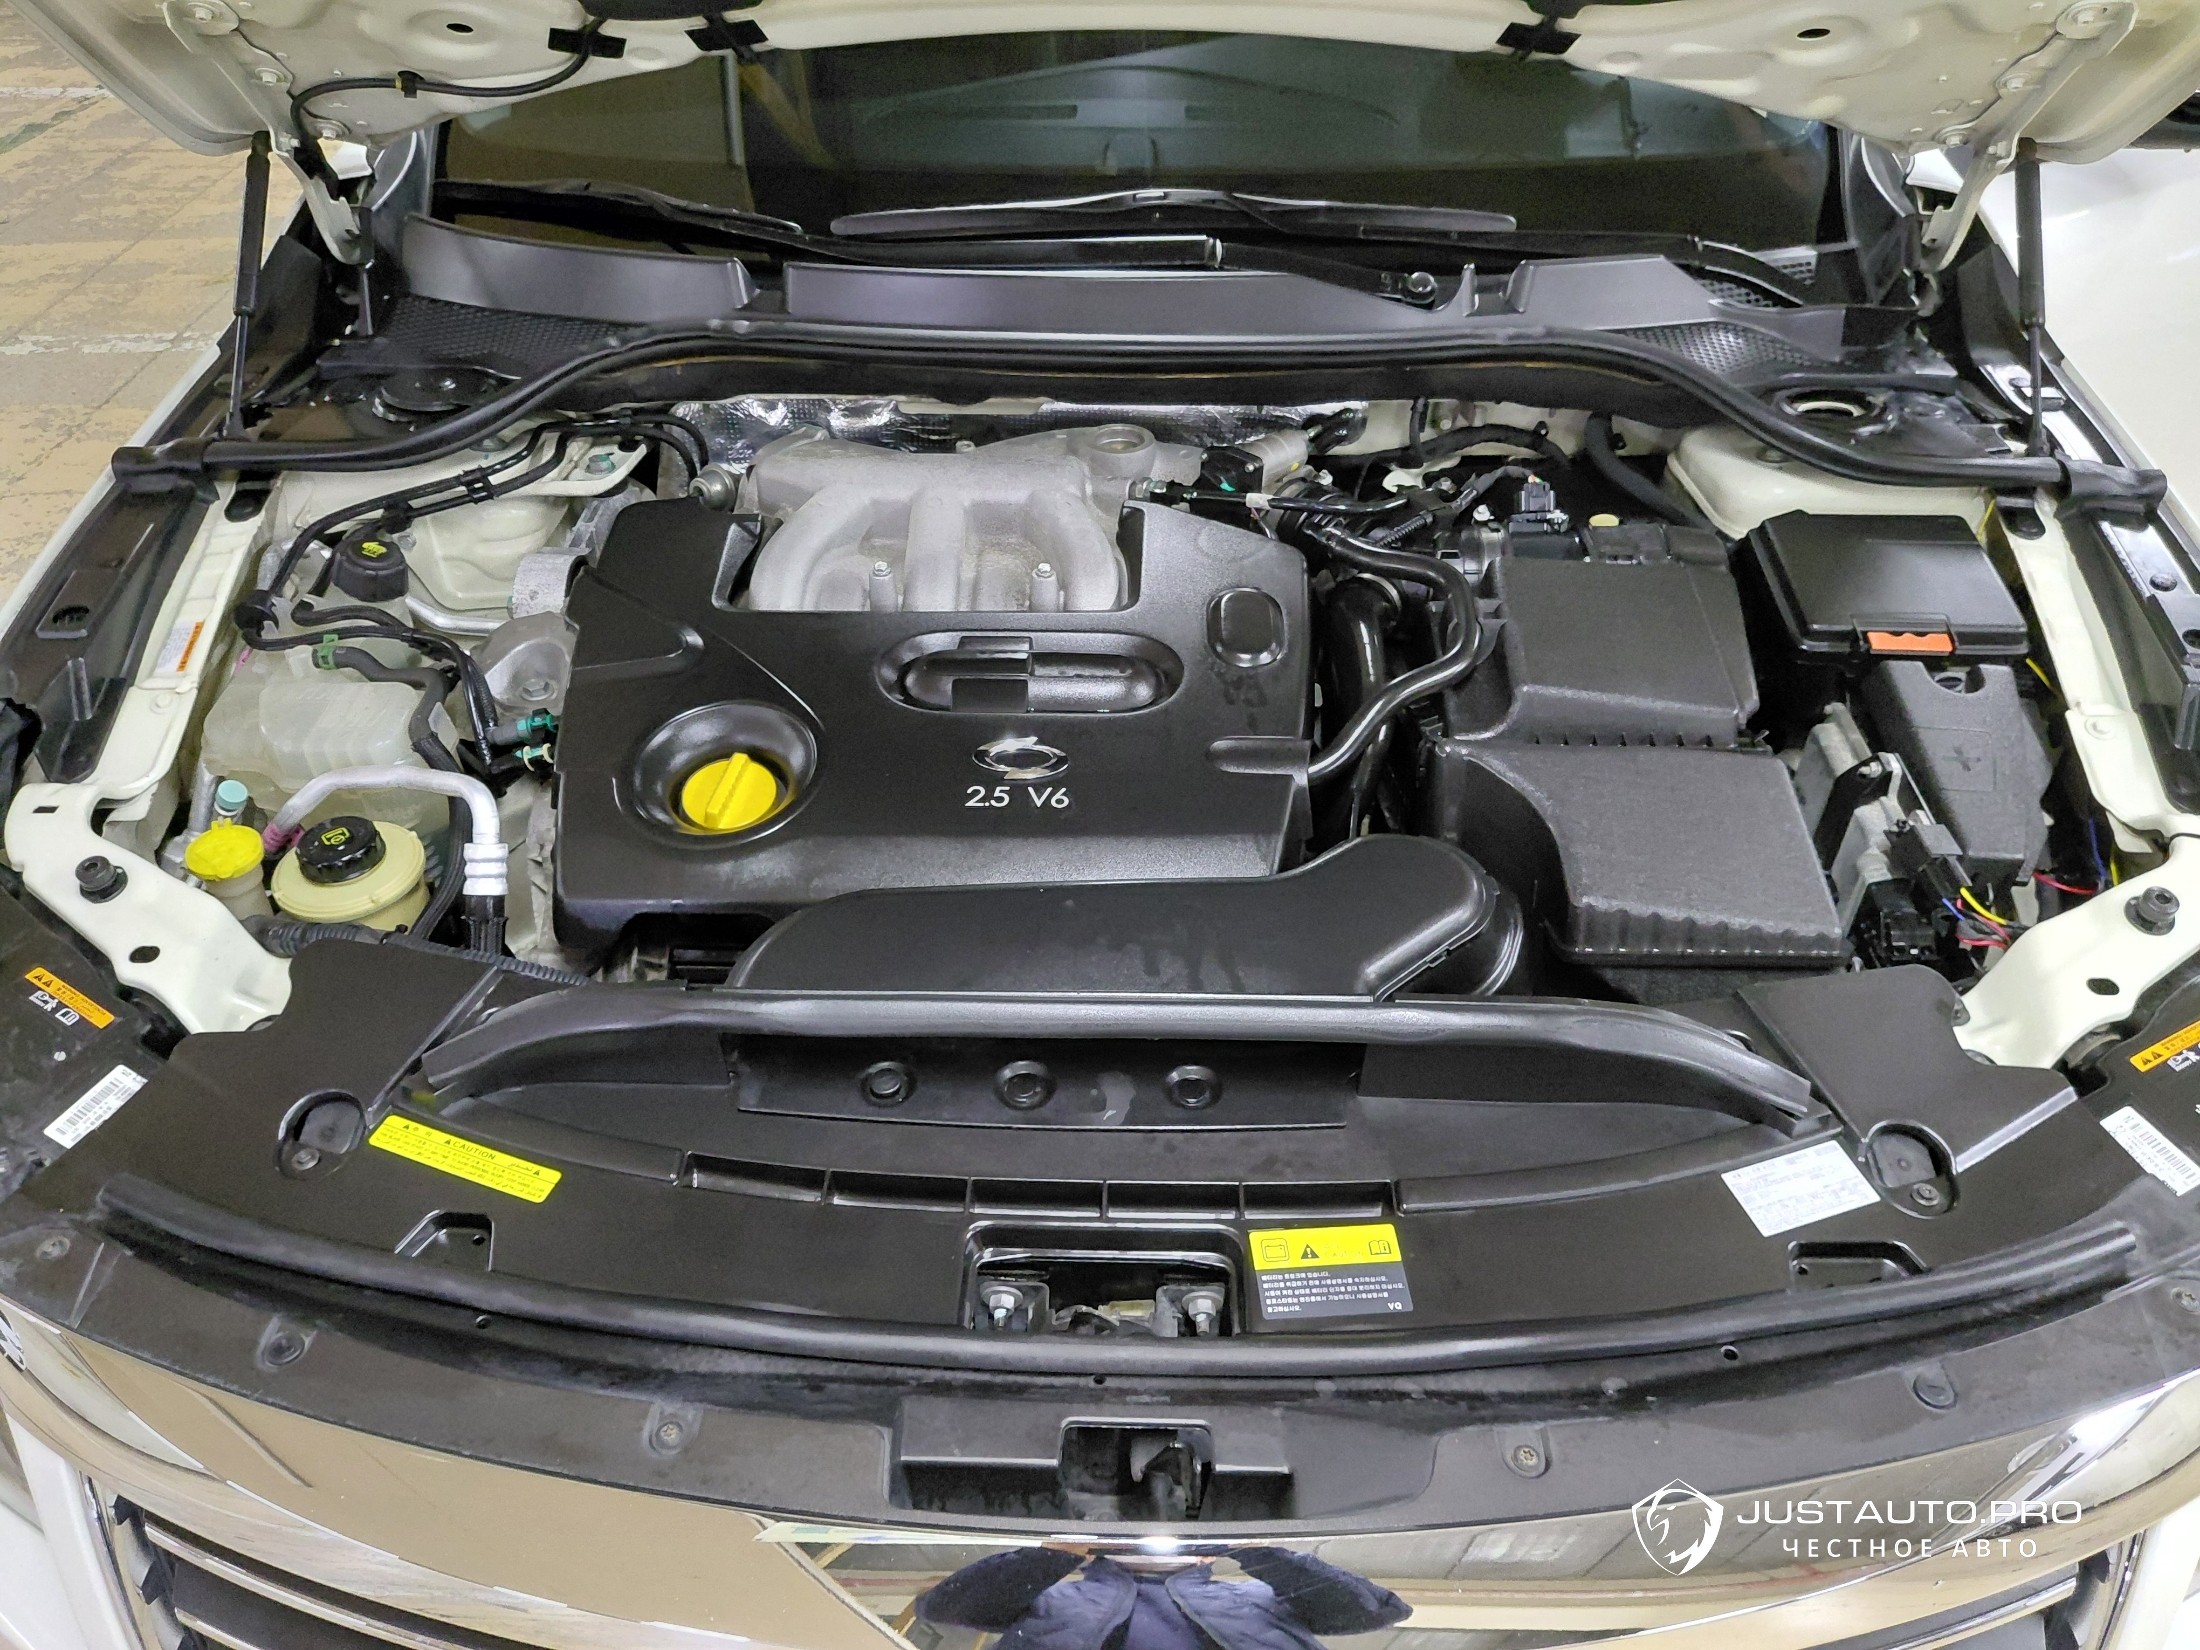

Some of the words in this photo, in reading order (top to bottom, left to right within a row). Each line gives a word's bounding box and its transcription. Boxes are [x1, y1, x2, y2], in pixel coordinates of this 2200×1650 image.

[965, 785, 1010, 808] 2.5
[1027, 786, 1070, 809] V6
[452, 1140, 496, 1161] CAUTION
